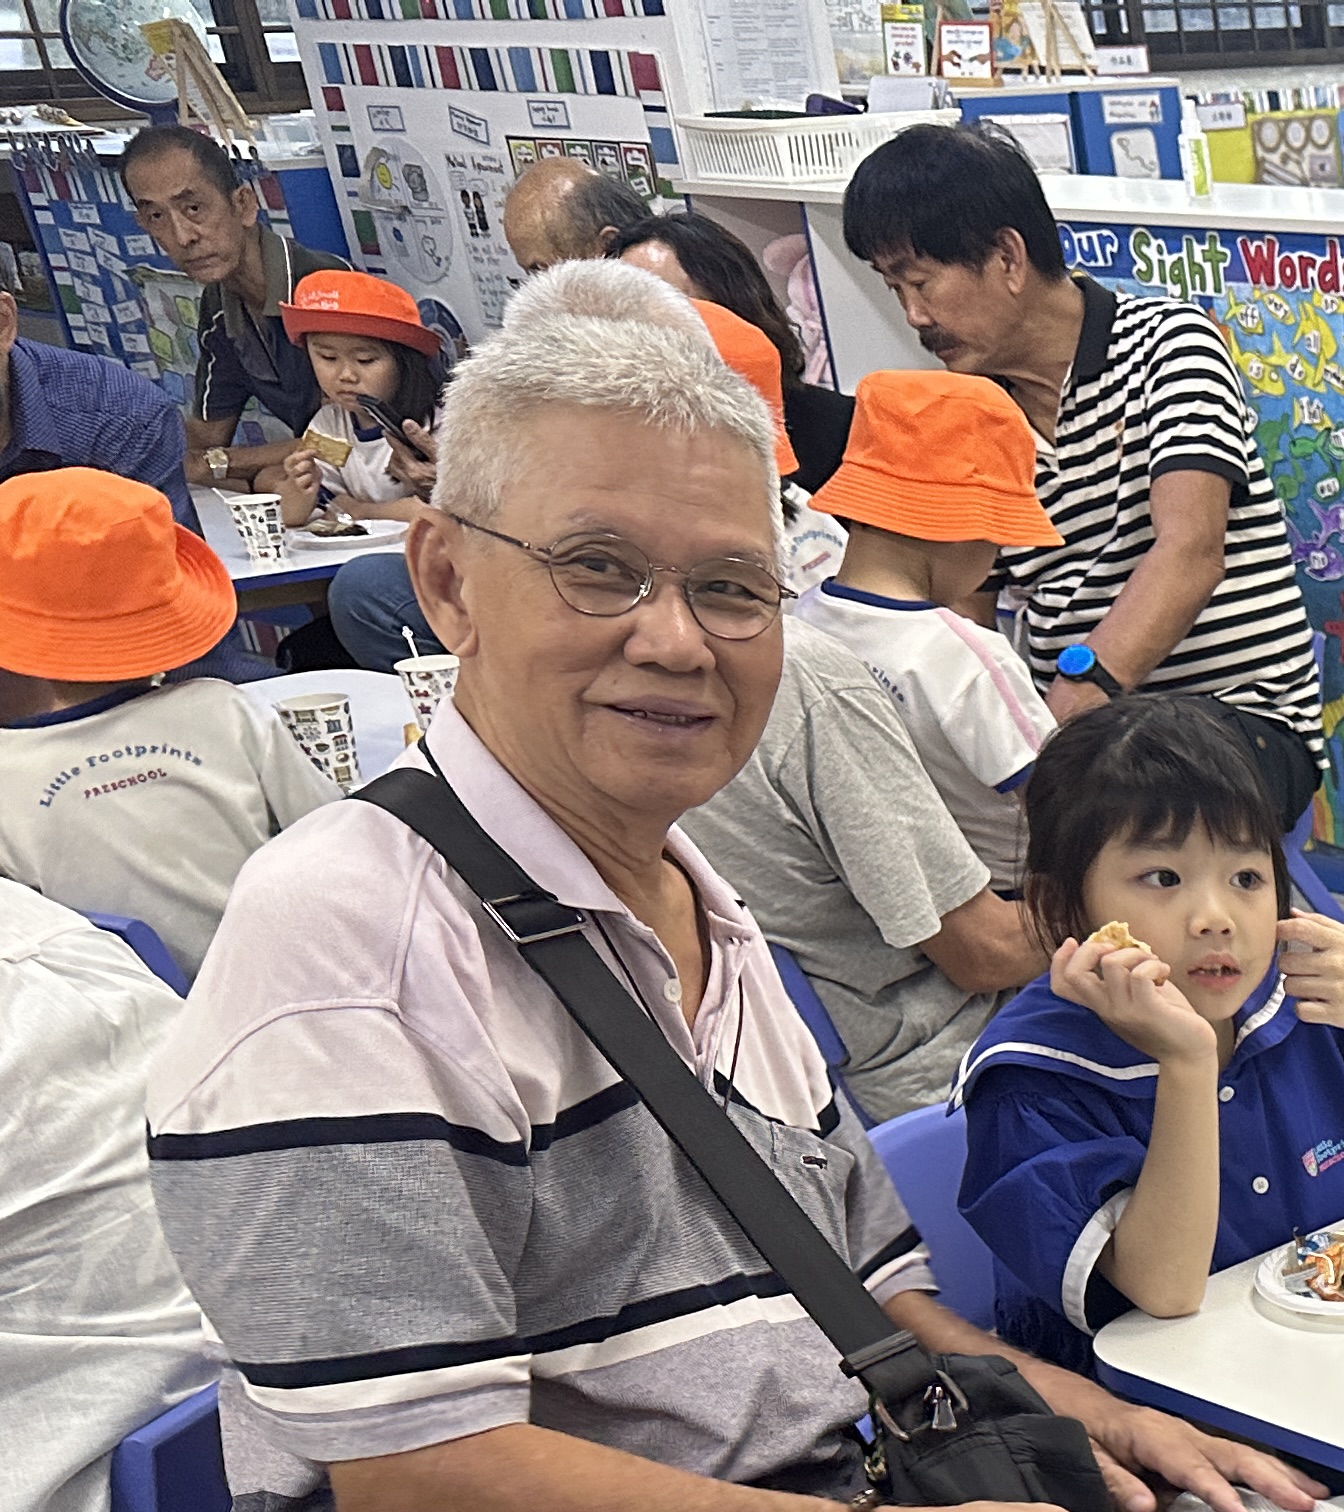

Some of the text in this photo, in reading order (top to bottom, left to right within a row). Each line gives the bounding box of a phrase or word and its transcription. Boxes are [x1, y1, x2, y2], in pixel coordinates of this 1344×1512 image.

[1062, 227, 1118, 267] Our
[1132, 230, 1229, 299] Sight
[1240, 305, 1257, 327] off
[40, 744, 202, 807] Little Footprints
[84, 768, 167, 799] PRESCHOOL
